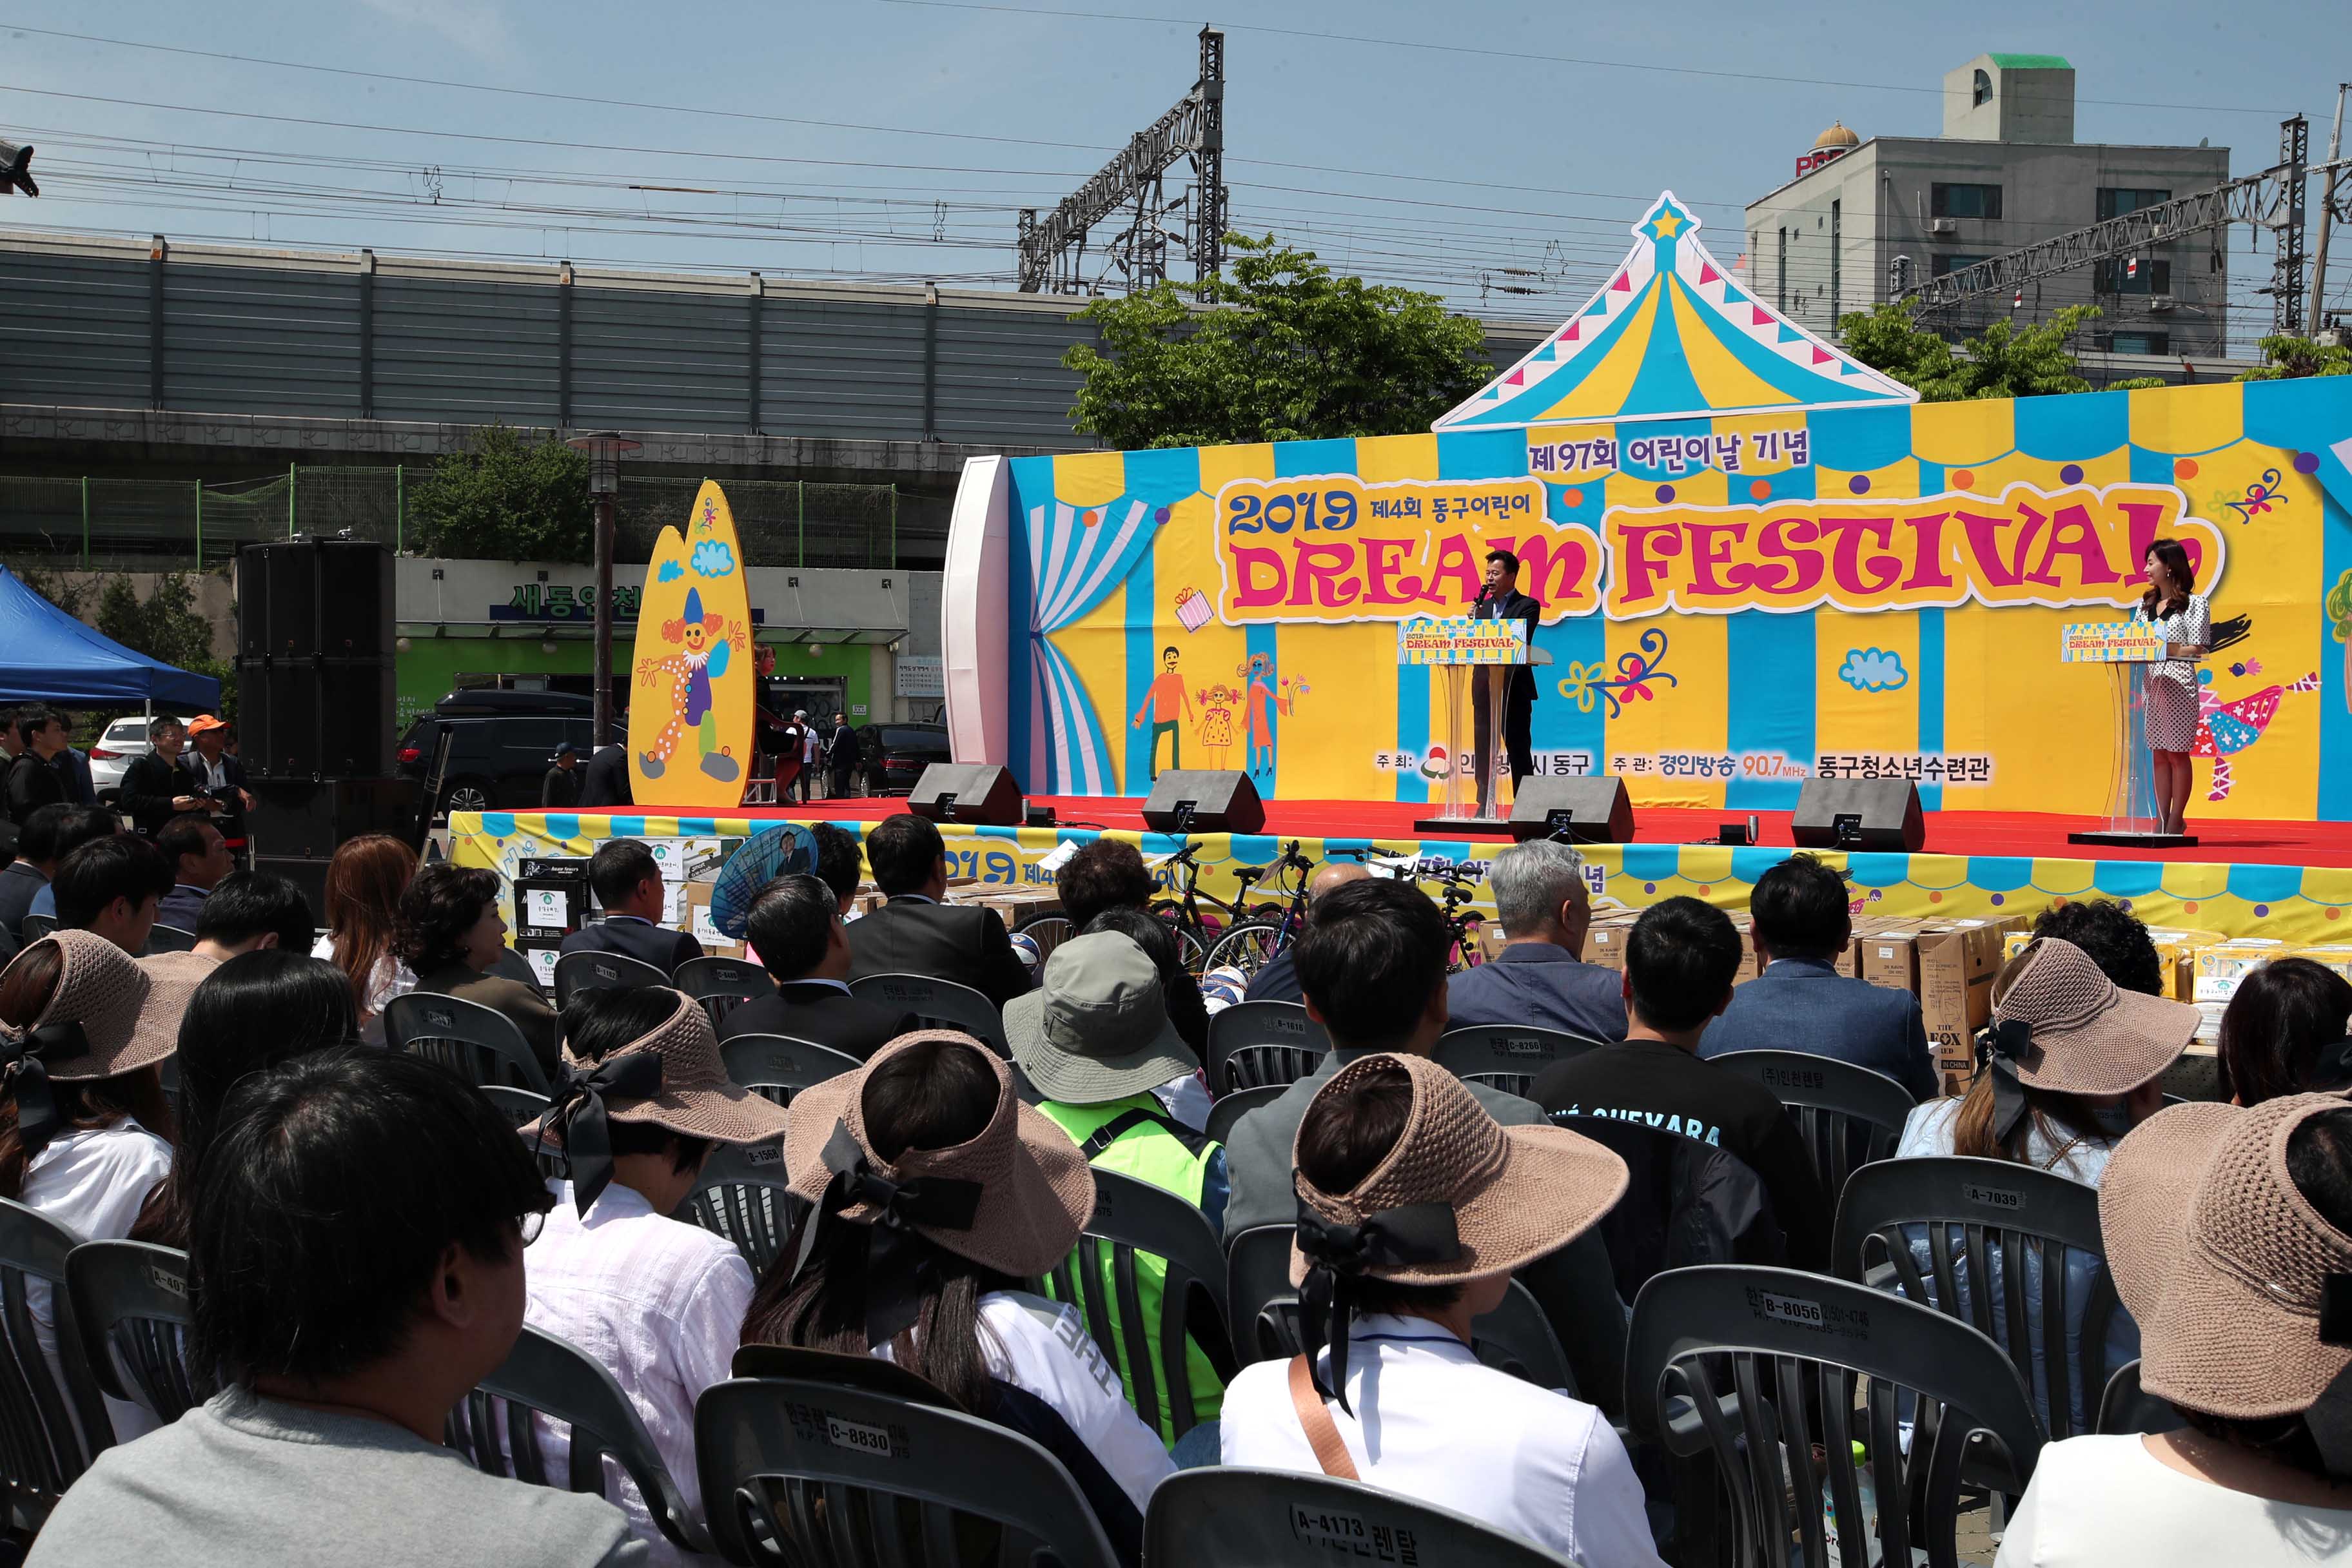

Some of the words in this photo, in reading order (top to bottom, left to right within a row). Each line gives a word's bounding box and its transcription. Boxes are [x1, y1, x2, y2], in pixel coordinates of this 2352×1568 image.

[1529, 438, 1617, 471] 제97회
[1630, 435, 1741, 471] 어린이날
[1752, 430, 1807, 466] 기념
[1228, 491, 1357, 535] 2019
[1371, 496, 1422, 520] 제4회
[1431, 494, 1530, 524] 동구어린이
[1229, 533, 1587, 609] DREAM
[1618, 502, 2200, 603] FESTIVAL
[1406, 638, 1451, 649] DREAM
[1453, 638, 1514, 649] FESTIVAL
[2069, 640, 2105, 649] DREAM
[2108, 638, 2157, 648] FESTIVAL
[1553, 754, 1589, 775] 동구
[1658, 754, 1736, 777] 경인방송
[1817, 755, 1990, 782] 동구청소년수련관
[1972, 1189, 2017, 1206] A-7039
[1765, 1298, 1820, 1320] B-8056
[830, 1423, 888, 1451] C-8830
[1297, 1511, 1365, 1537] A-4173
